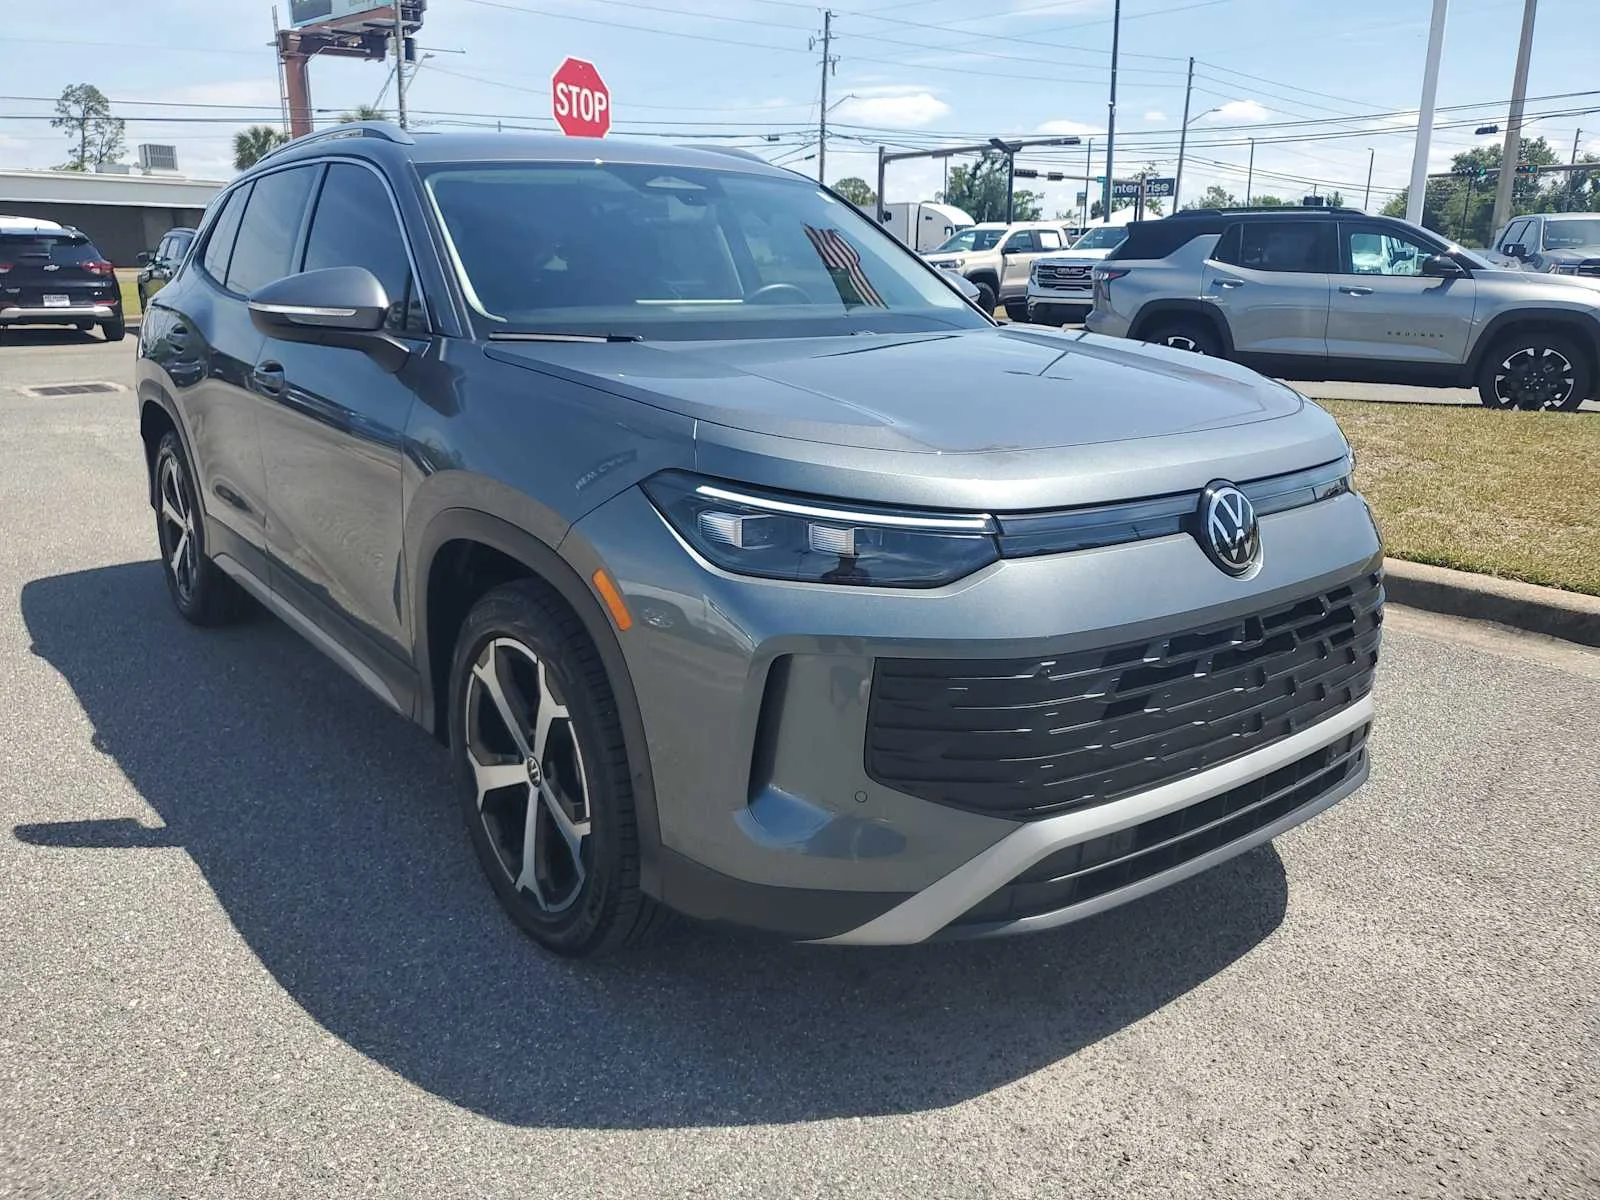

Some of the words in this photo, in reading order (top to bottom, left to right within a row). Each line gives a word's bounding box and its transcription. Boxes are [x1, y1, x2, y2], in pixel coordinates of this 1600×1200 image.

[556, 82, 607, 123] STOP
[1110, 181, 1169, 195] nterrise
[1056, 267, 1085, 275] GMC
[1208, 487, 1257, 569] VW
